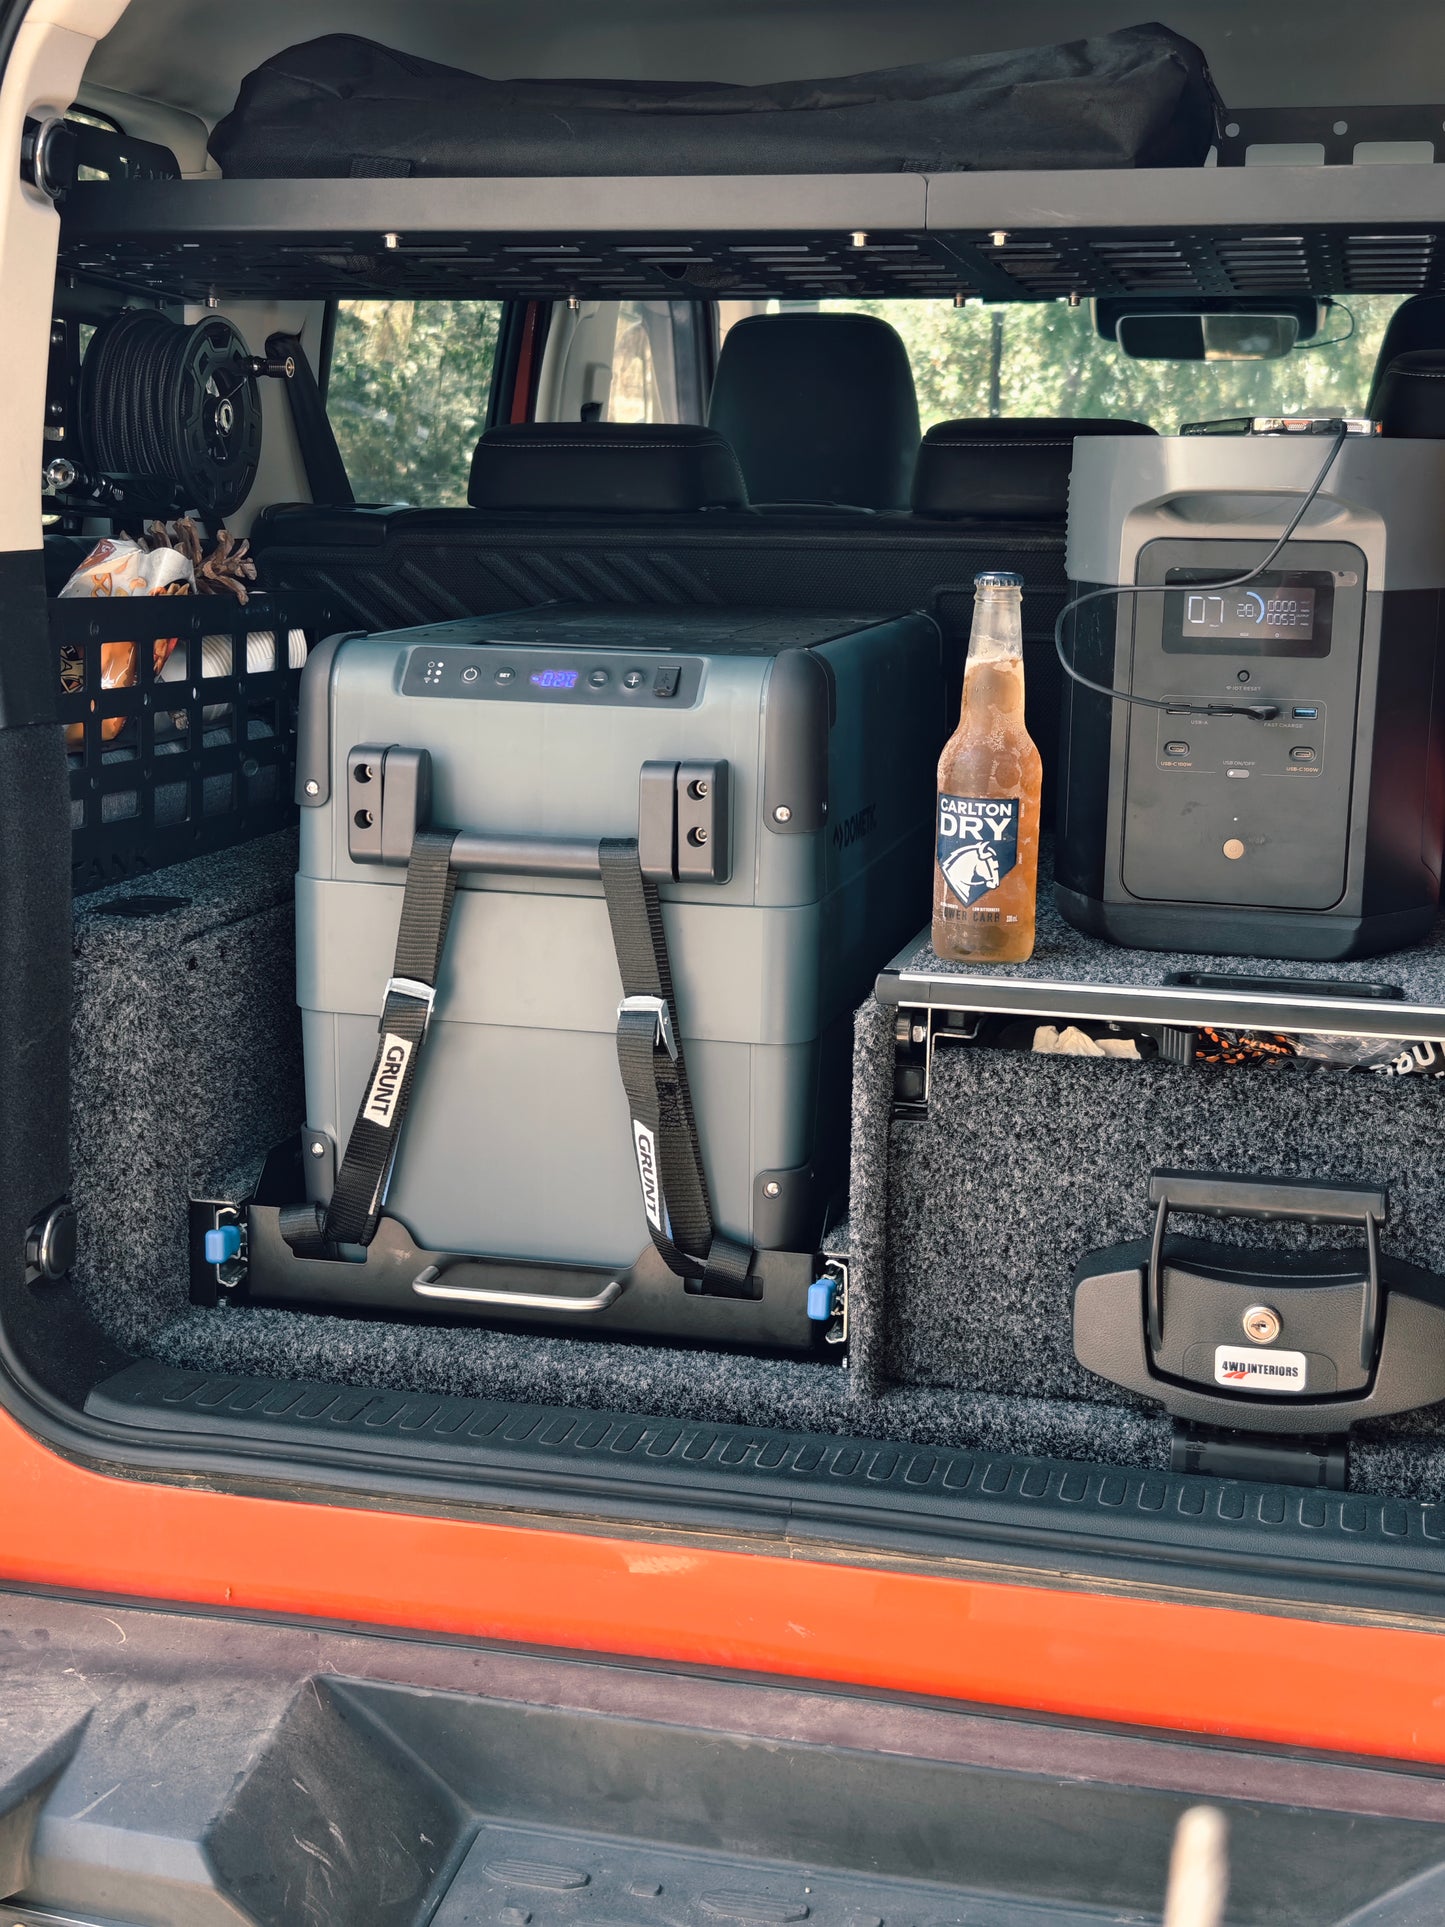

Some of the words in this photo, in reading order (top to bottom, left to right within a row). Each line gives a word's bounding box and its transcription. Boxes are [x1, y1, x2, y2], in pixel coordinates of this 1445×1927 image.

[940, 798, 1012, 817] CARLTON
[940, 812, 1012, 841] DRY
[973, 911, 1000, 923] CARB
[371, 1045, 405, 1116] GRUNT
[638, 1134, 657, 1217] GRUNT
[1222, 1361, 1246, 1373] 4WD
[1248, 1363, 1299, 1378] INTERIORS
